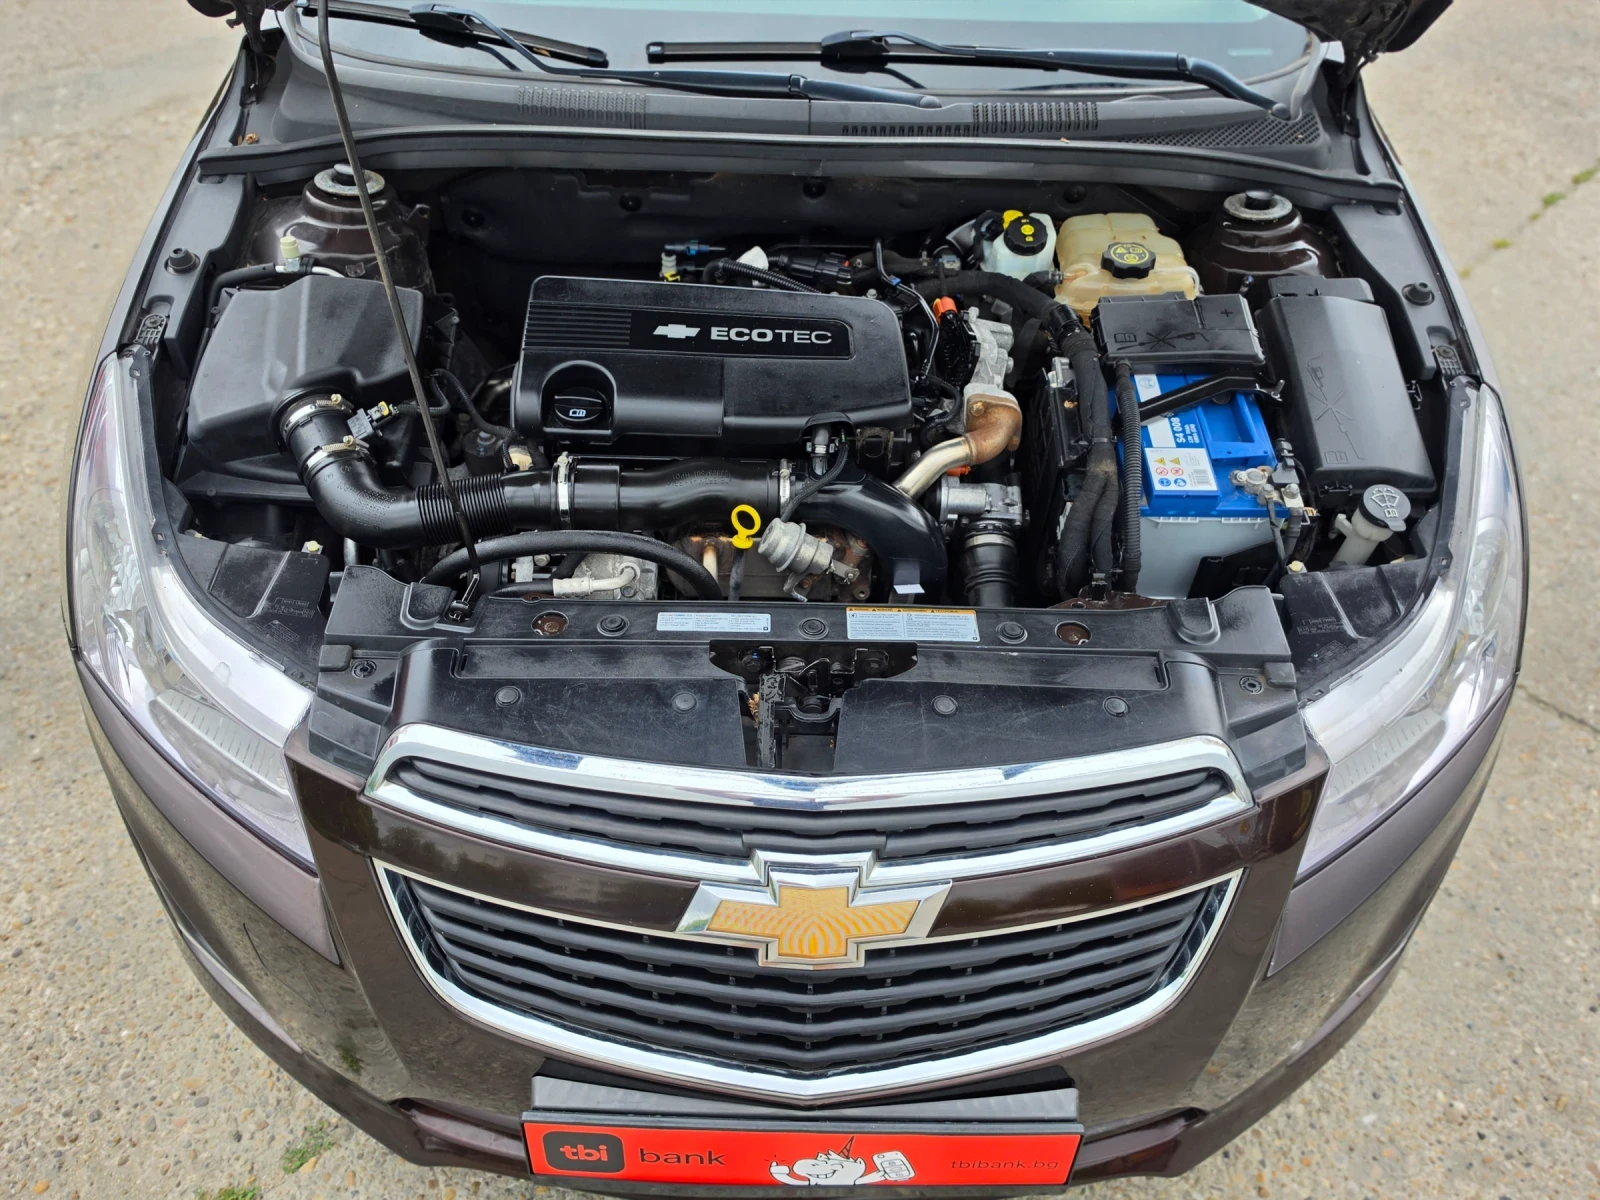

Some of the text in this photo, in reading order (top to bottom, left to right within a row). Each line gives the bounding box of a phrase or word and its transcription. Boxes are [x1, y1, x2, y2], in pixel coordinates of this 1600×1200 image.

[710, 326, 832, 344] ECOTEC
[1170, 417, 1186, 443] S4 008
[560, 1145, 727, 1166] tbi bank
[951, 1160, 1059, 1169] tbibank.bg
